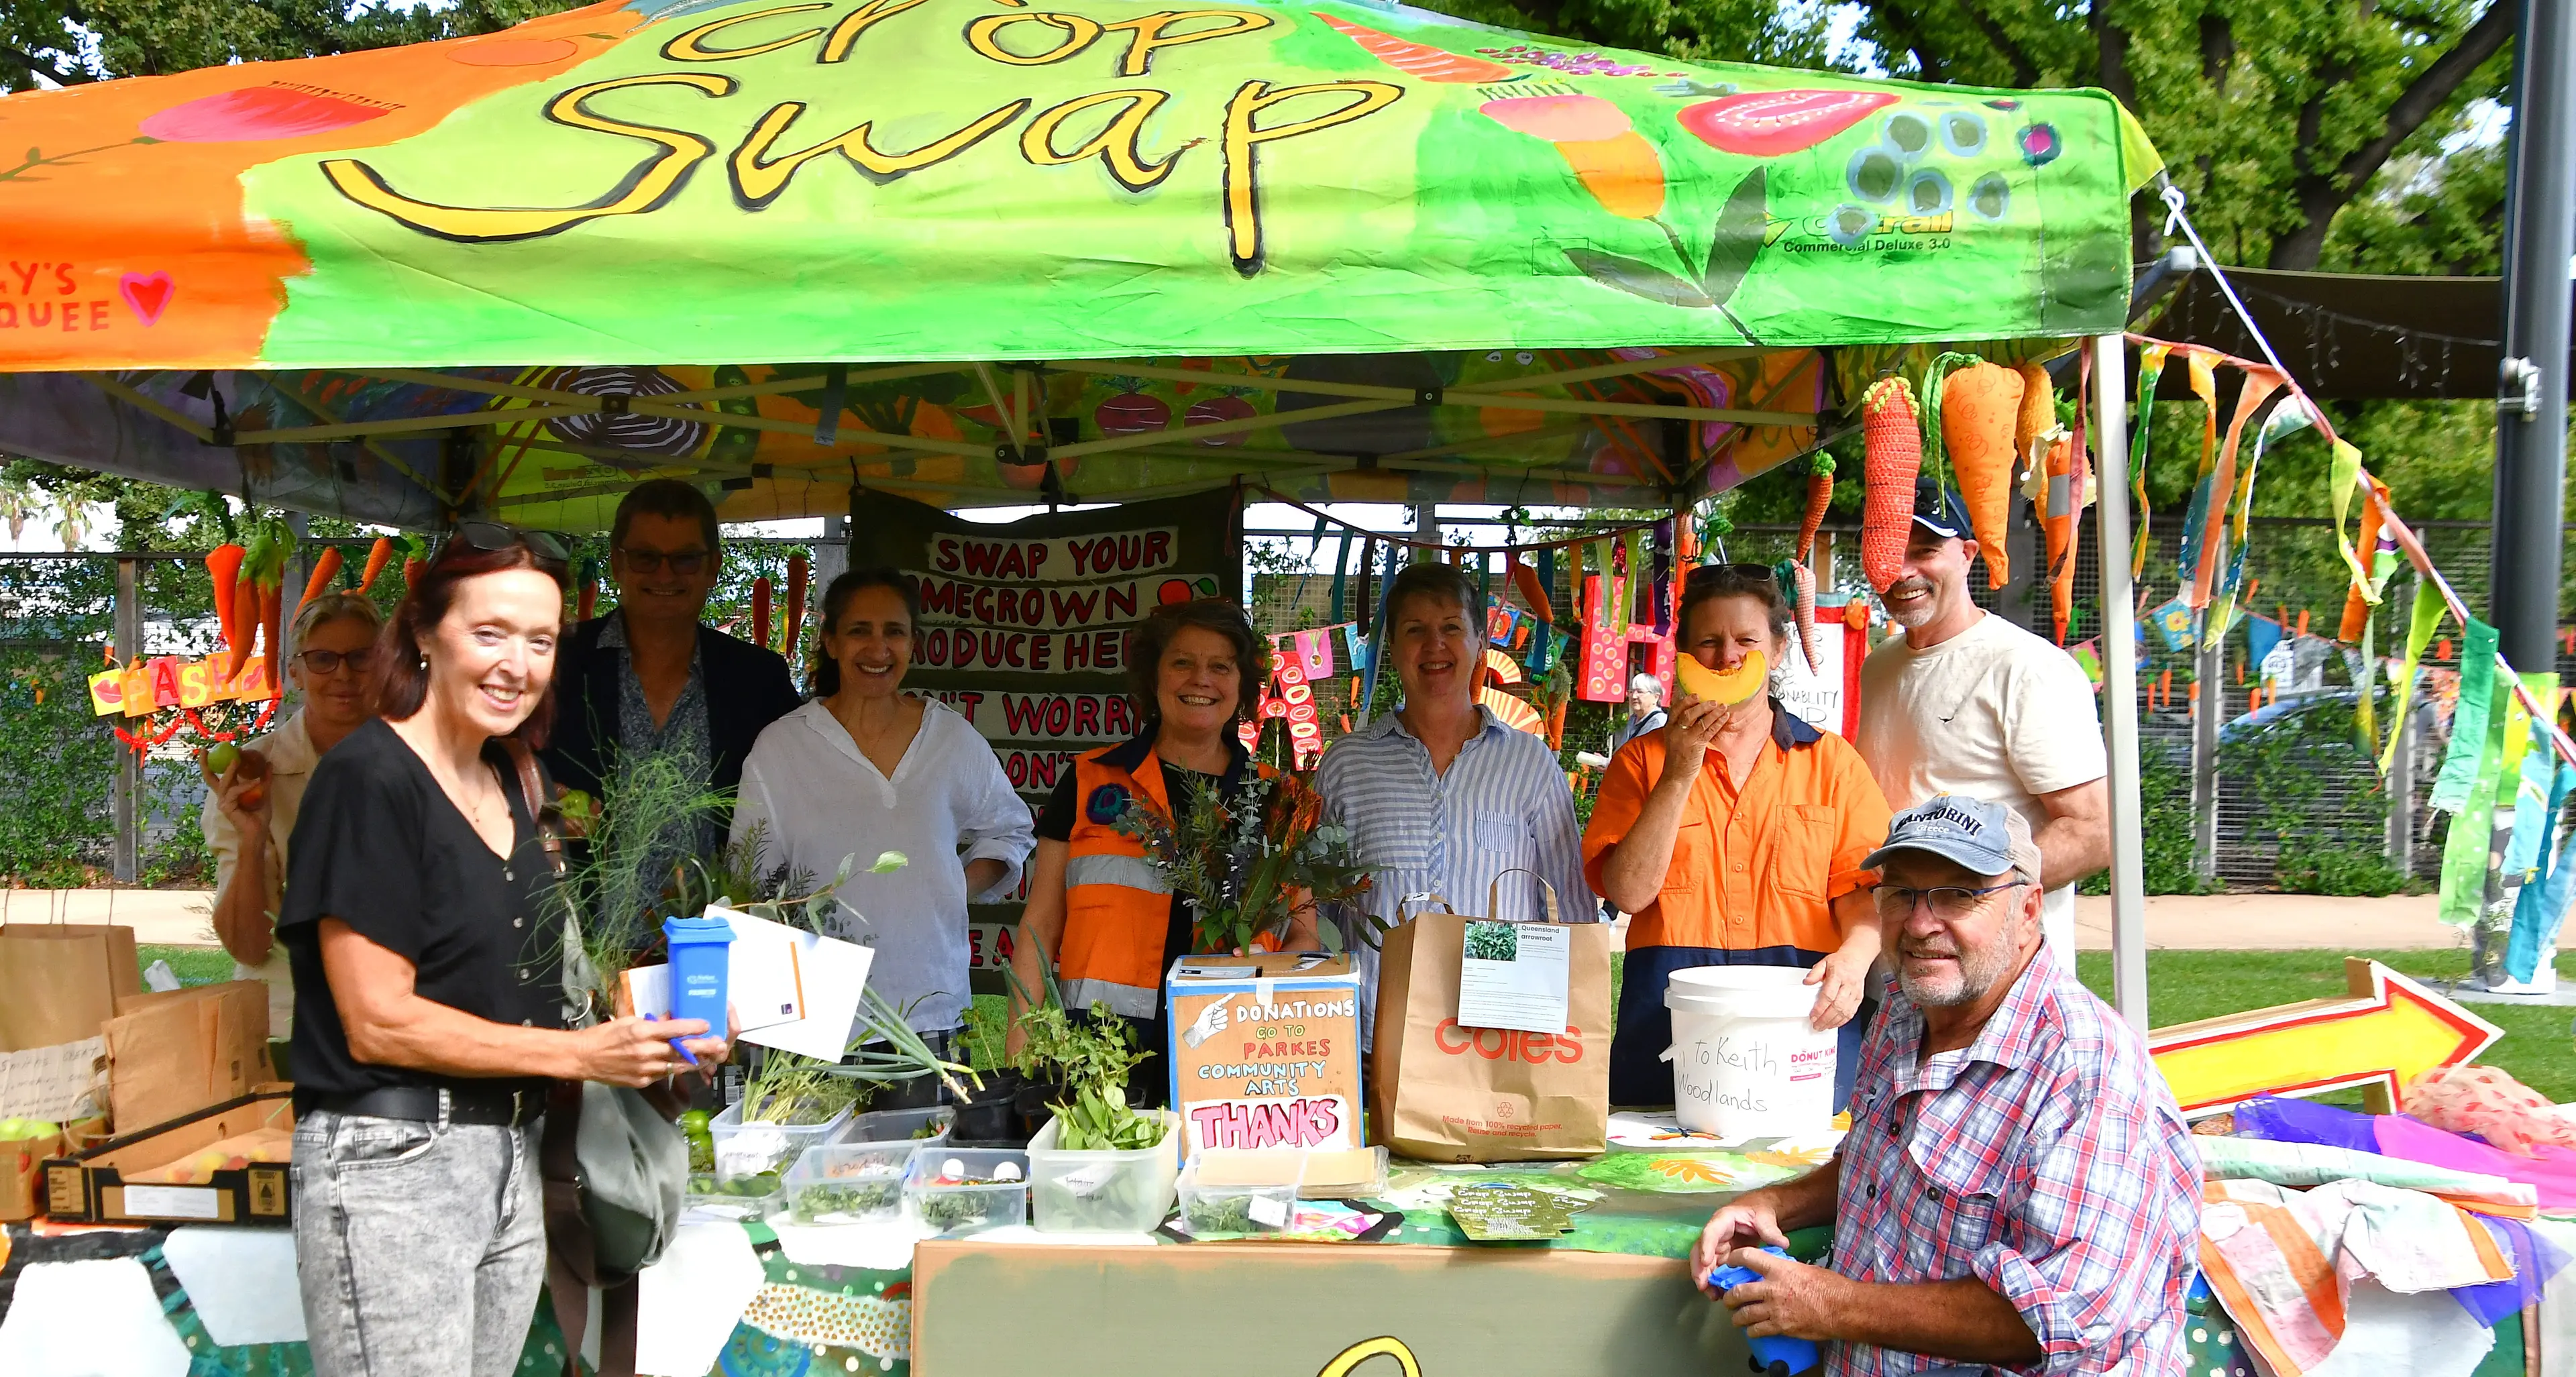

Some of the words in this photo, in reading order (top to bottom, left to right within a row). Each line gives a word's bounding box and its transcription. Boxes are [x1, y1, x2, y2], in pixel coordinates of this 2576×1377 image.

[319, 71, 1406, 276] Swap
[1784, 239, 1870, 253] Commeral
[1874, 239, 1924, 252] Deluxe
[1928, 238, 1951, 249] 3.0
[0, 260, 76, 296] Y'S
[936, 539, 1048, 580] SWAP
[1068, 531, 1171, 577] YOUR
[909, 574, 1137, 626] MEGROWN
[910, 627, 1052, 670] RODUCE
[1064, 630, 1131, 671] HE
[127, 656, 235, 712] PASH
[1917, 824, 1949, 832] Greece
[1521, 925, 1560, 934] Queensland
[1236, 999, 1355, 1023] DONATIONS
[1256, 1026, 1277, 1040] GO
[1283, 1024, 1305, 1037] TO
[1244, 1038, 1331, 1060] PARKES
[1717, 1036, 1778, 1076] Keith
[1790, 1050, 1823, 1063] DONUT
[1198, 1060, 1327, 1079] COMMUNITY
[1245, 1079, 1300, 1097] ARTS
[1677, 1070, 1768, 1111] Woodlands
[1191, 1099, 1339, 1150] THANKS
[1442, 1115, 1464, 1124] Made
[1466, 1118, 1483, 1127] from
[1485, 1121, 1505, 1129] 100%
[1507, 1123, 1542, 1132] recycled
[1468, 1127, 1490, 1136] Reuse
[1492, 1127, 1507, 1136] and
